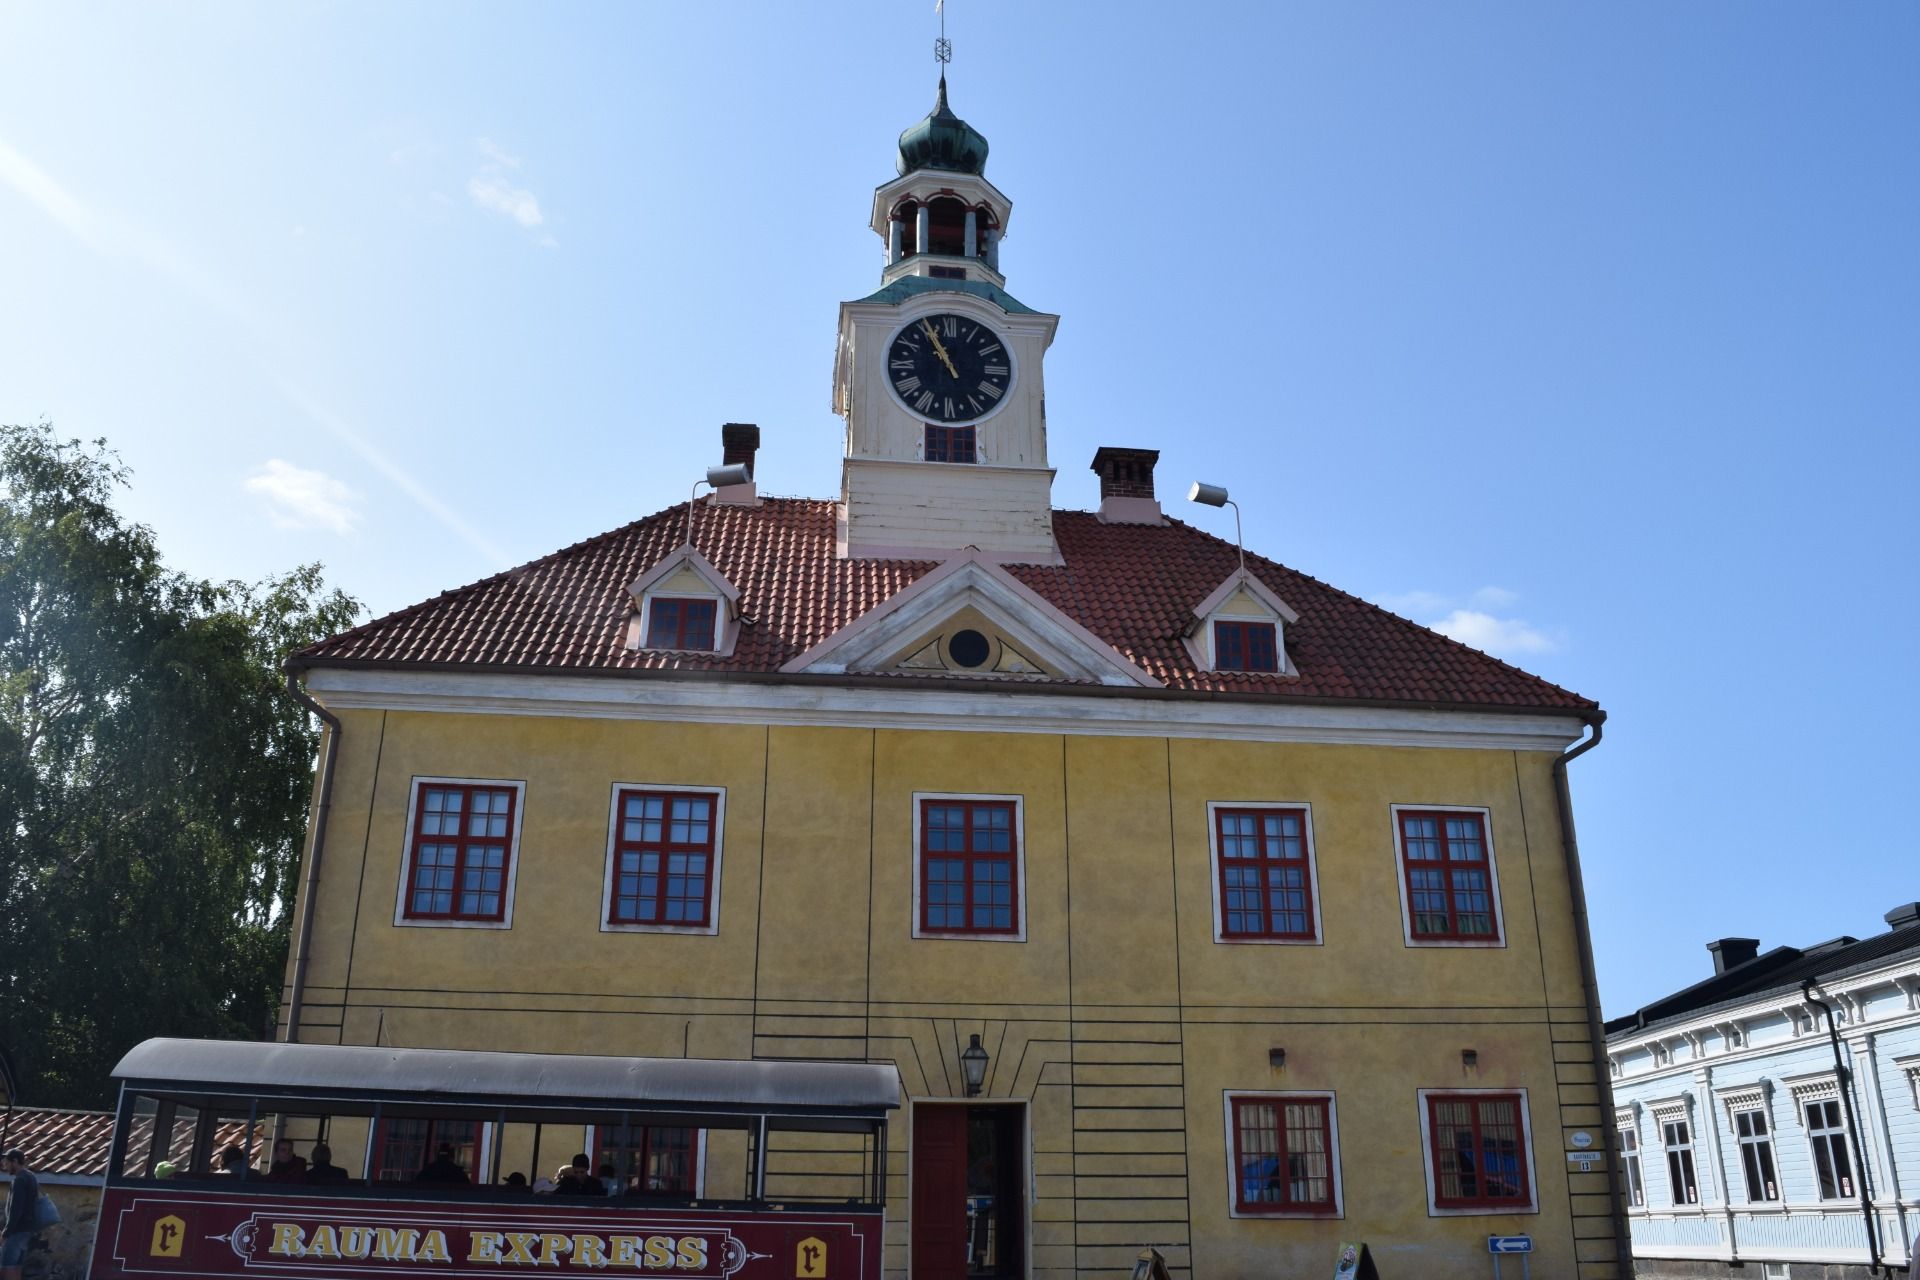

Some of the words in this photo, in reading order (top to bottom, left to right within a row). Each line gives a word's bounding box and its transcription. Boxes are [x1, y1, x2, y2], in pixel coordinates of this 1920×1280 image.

[1582, 1162, 1589, 1170] 13
[269, 1223, 452, 1264] RAUMA
[467, 1231, 708, 1269] EXPRESS
